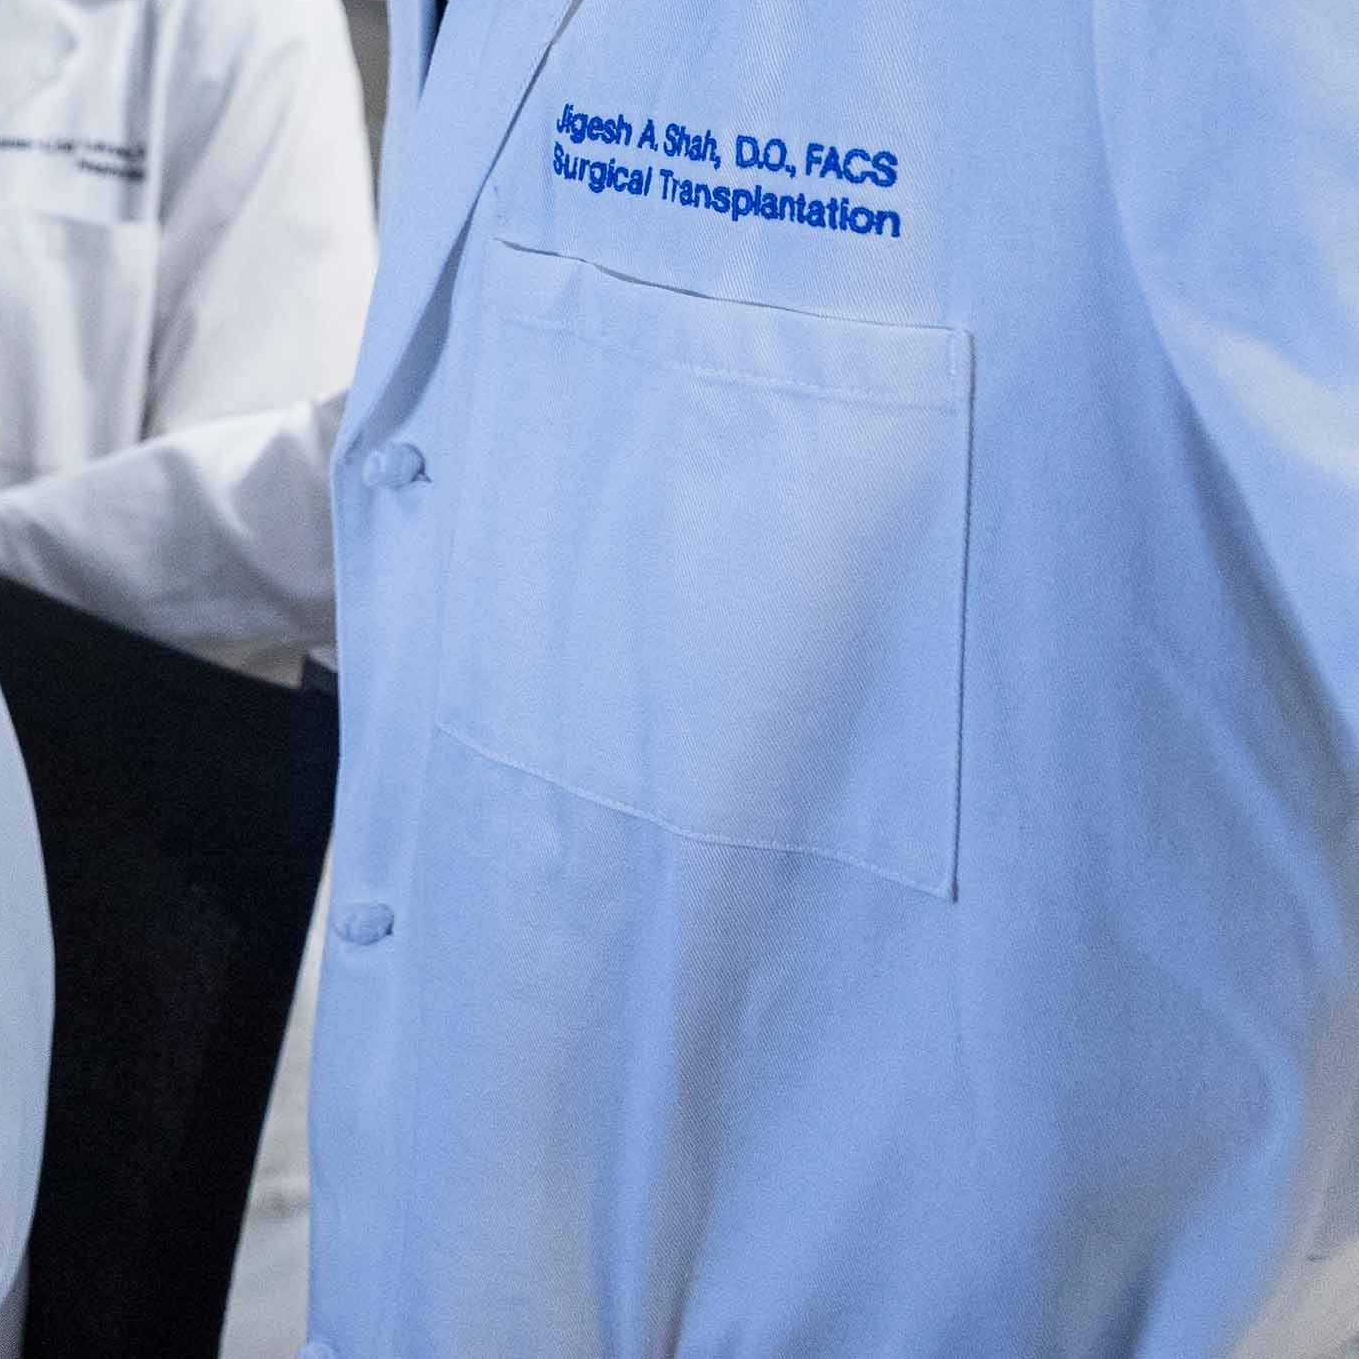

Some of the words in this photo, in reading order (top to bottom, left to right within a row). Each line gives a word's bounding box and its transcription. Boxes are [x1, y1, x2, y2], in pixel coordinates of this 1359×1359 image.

[553, 141, 652, 194] Surgical
[658, 168, 901, 238] Transplantation
[556, 103, 632, 144] Jigesh
[663, 123, 721, 170] Shah,
[805, 142, 898, 188] FACS
